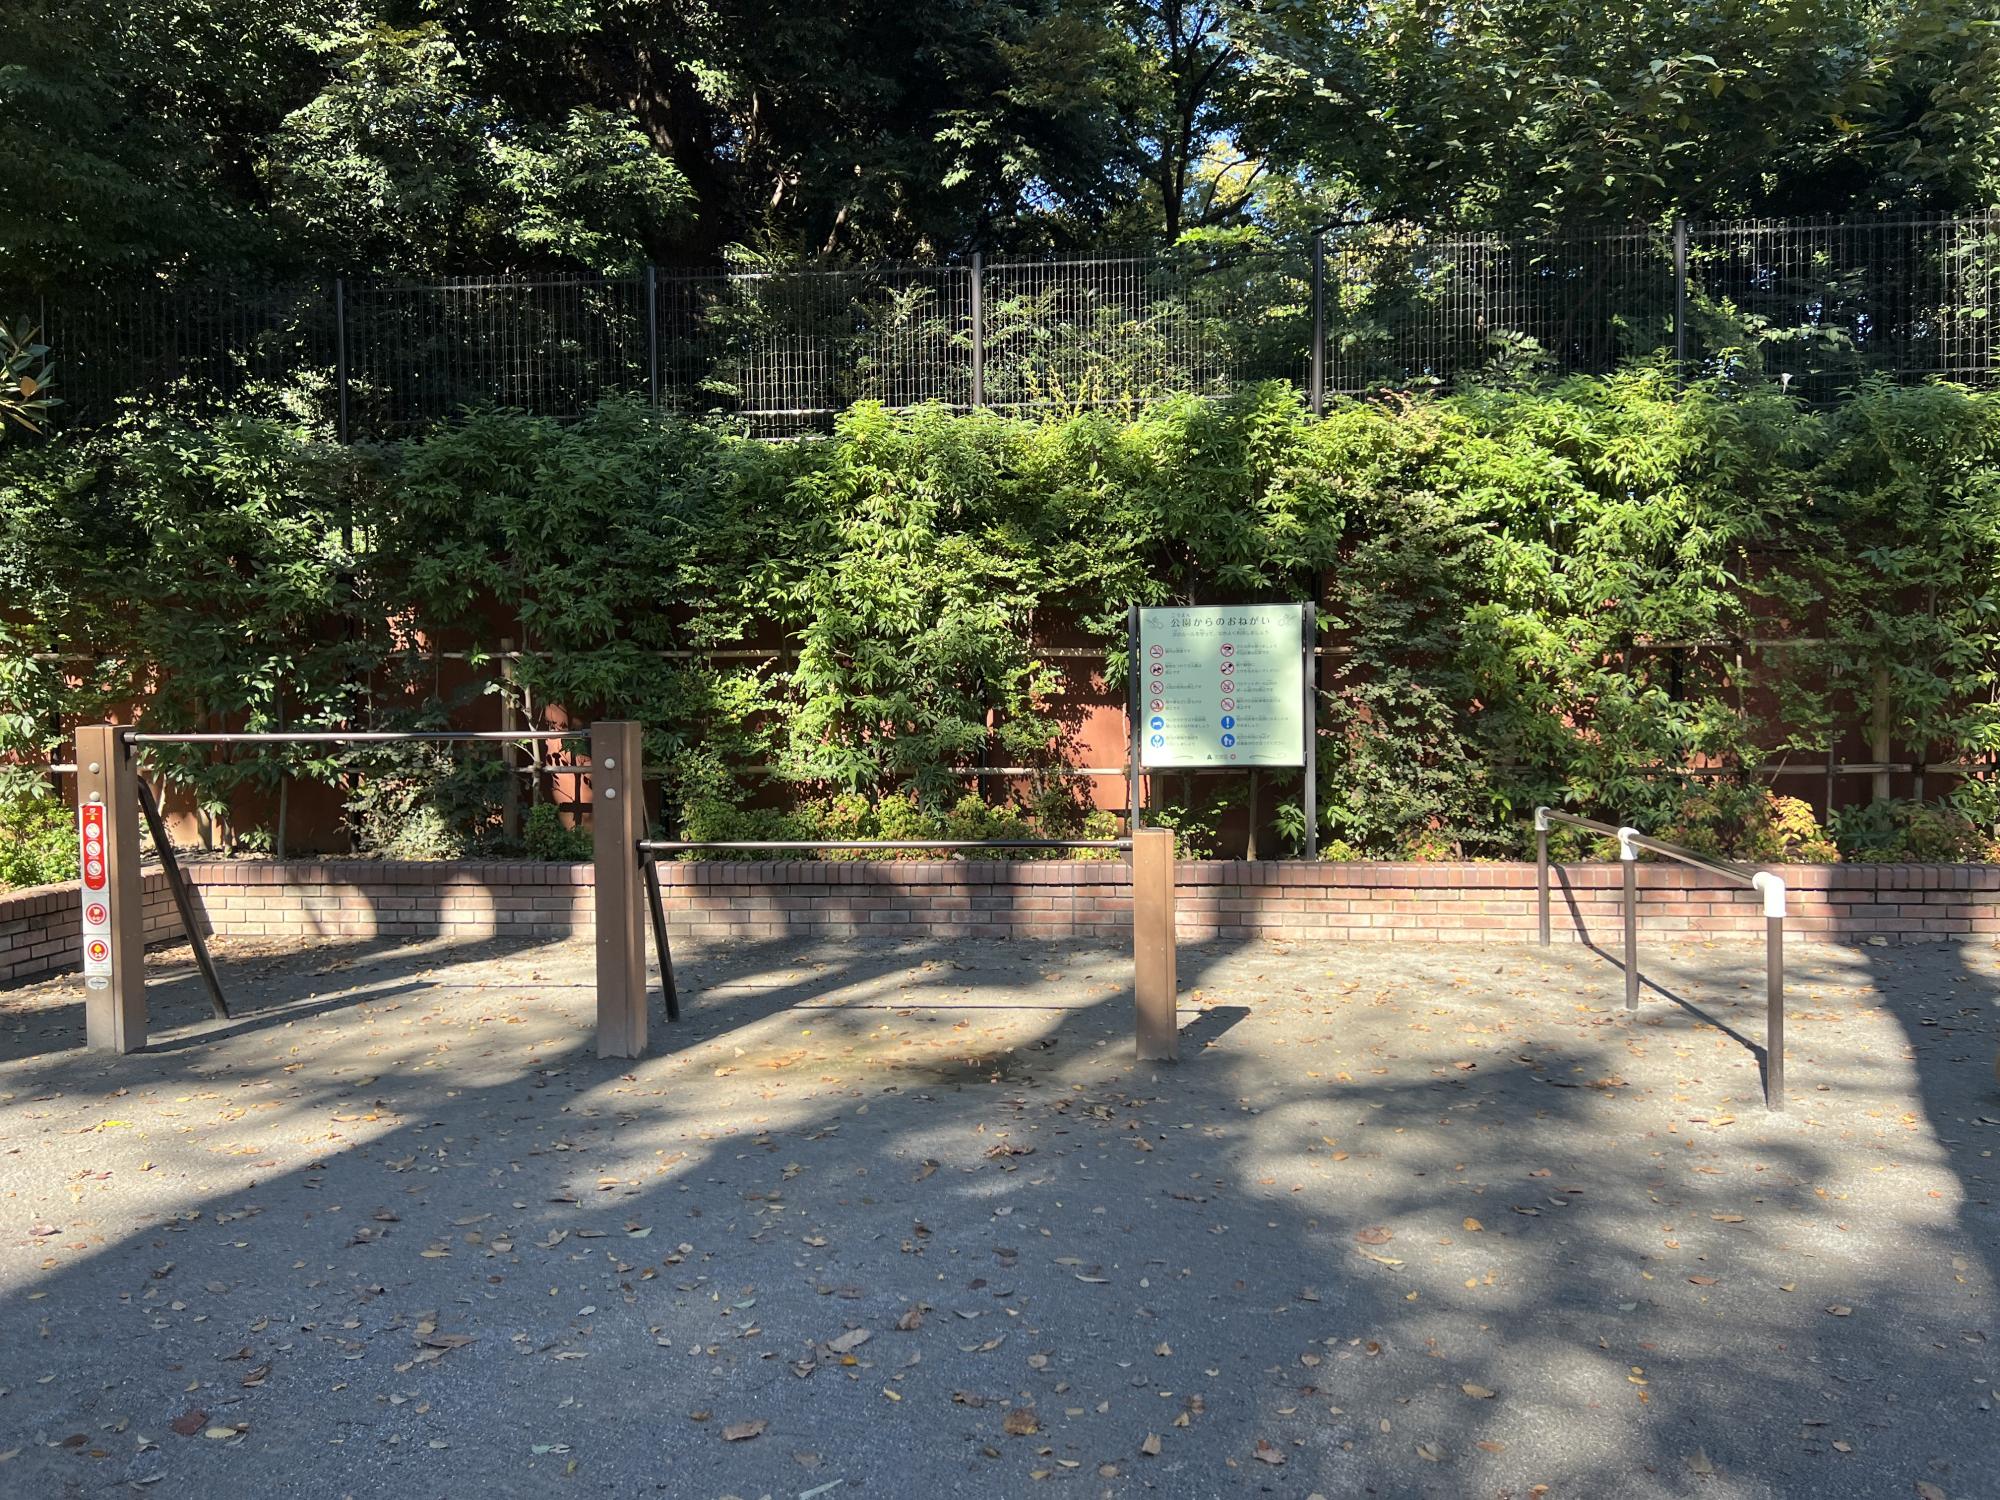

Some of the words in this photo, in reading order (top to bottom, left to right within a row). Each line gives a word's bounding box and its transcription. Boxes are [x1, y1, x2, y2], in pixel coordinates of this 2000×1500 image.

[1170, 616, 1270, 628] 公園からのおねがい
